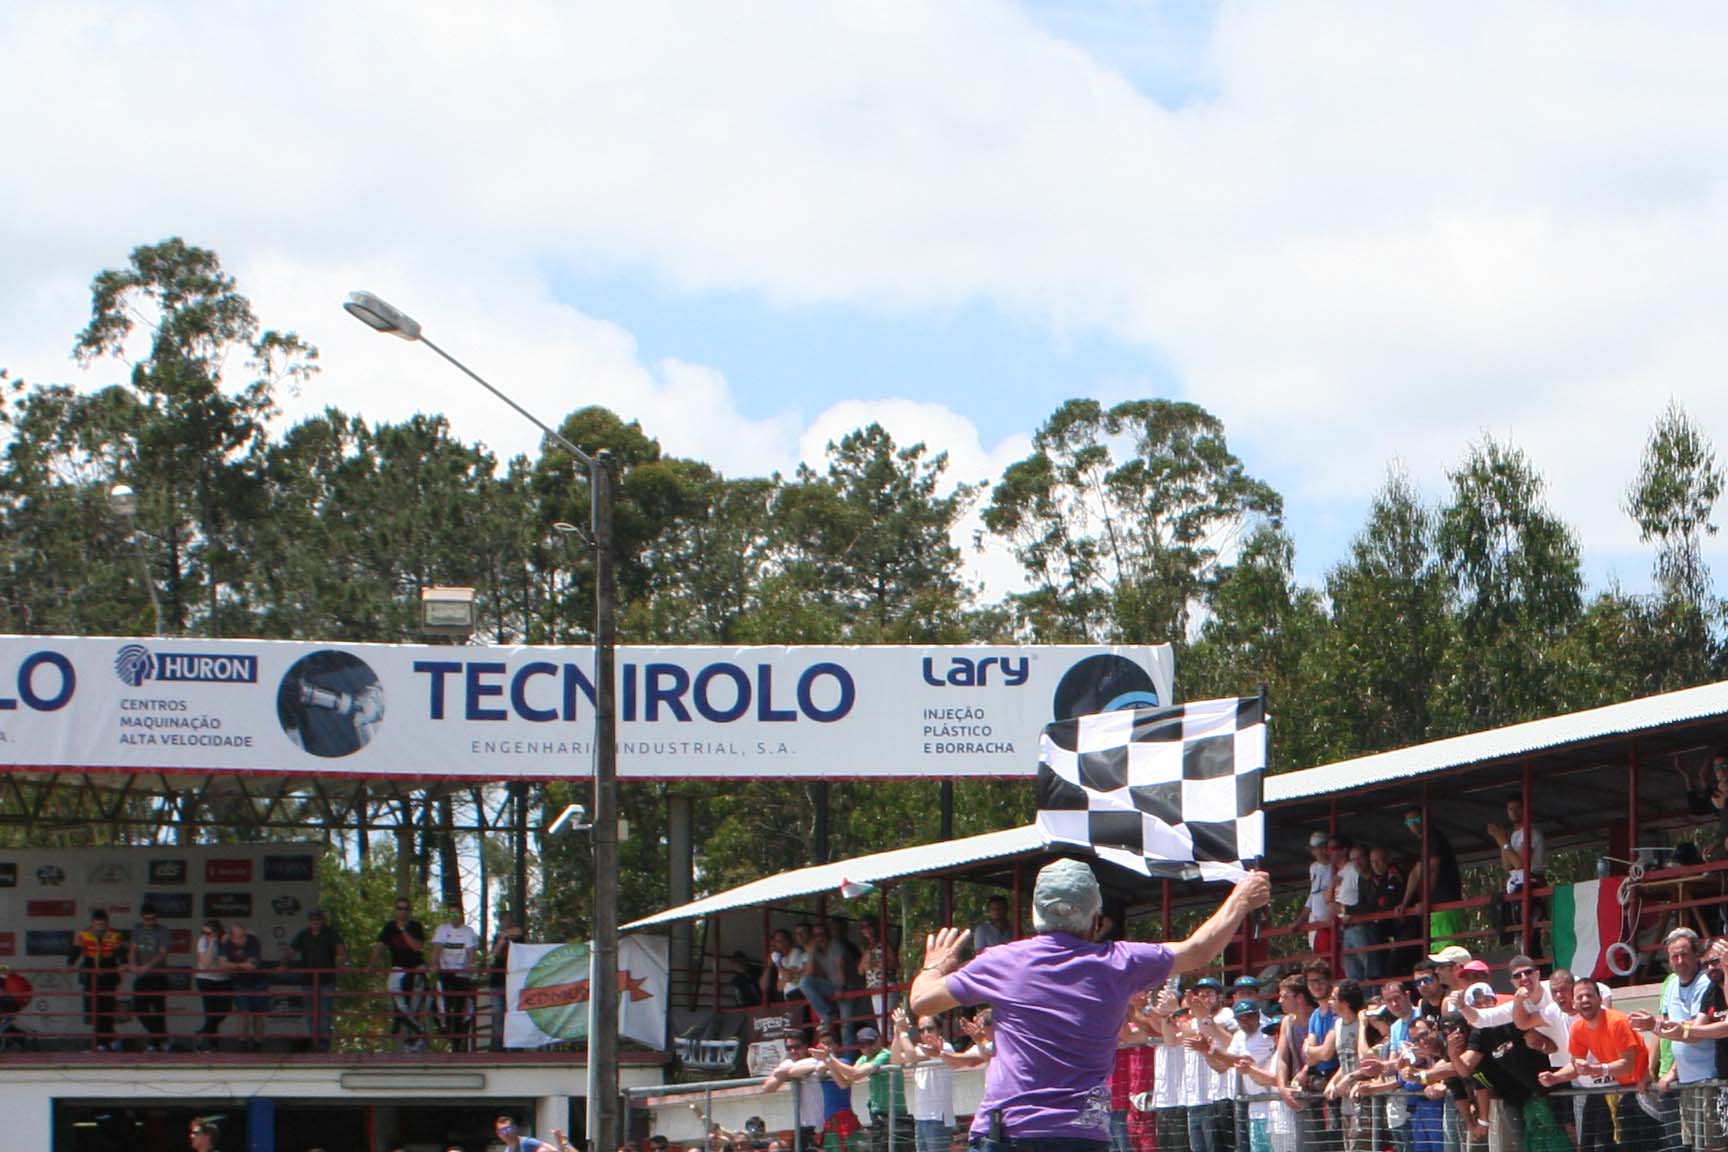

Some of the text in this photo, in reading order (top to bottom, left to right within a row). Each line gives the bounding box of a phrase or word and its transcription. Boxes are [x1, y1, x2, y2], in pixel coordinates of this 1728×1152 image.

[164, 657, 250, 680] HURON
[413, 661, 856, 723] TECNIROLO
[120, 699, 187, 711] CENTROS
[923, 707, 985, 721] INJEÇÃO
[120, 715, 221, 731] MAQUINAÇÃO
[923, 723, 992, 737] PLÁSTICO
[120, 734, 254, 748] ALTA VELOCIDADE
[471, 740, 591, 754] ENGENHARI
[757, 741, 797, 755] S.A.
[923, 743, 1015, 755] E BORRACHA
